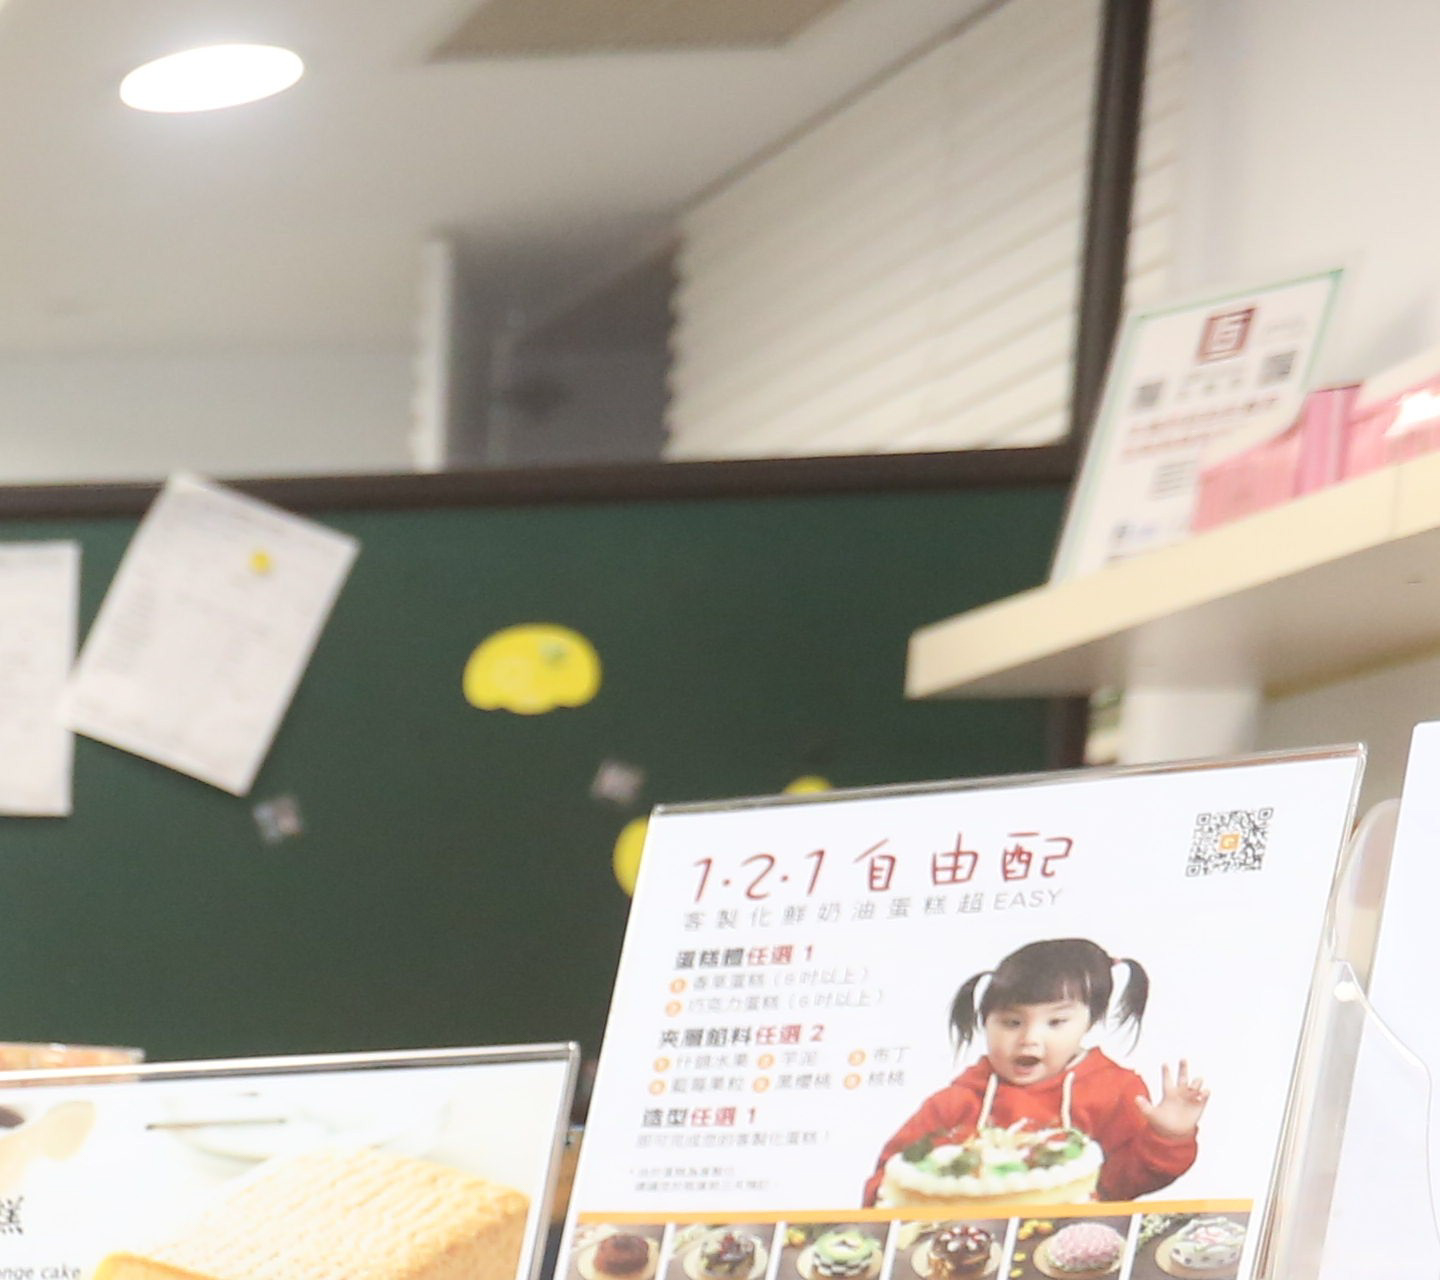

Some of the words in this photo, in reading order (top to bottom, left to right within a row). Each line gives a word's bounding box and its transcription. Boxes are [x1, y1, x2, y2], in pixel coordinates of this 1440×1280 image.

[852, 830, 1075, 893] 自由配
[993, 888, 1063, 911] EASY
[40, 1262, 82, 1280] cake
